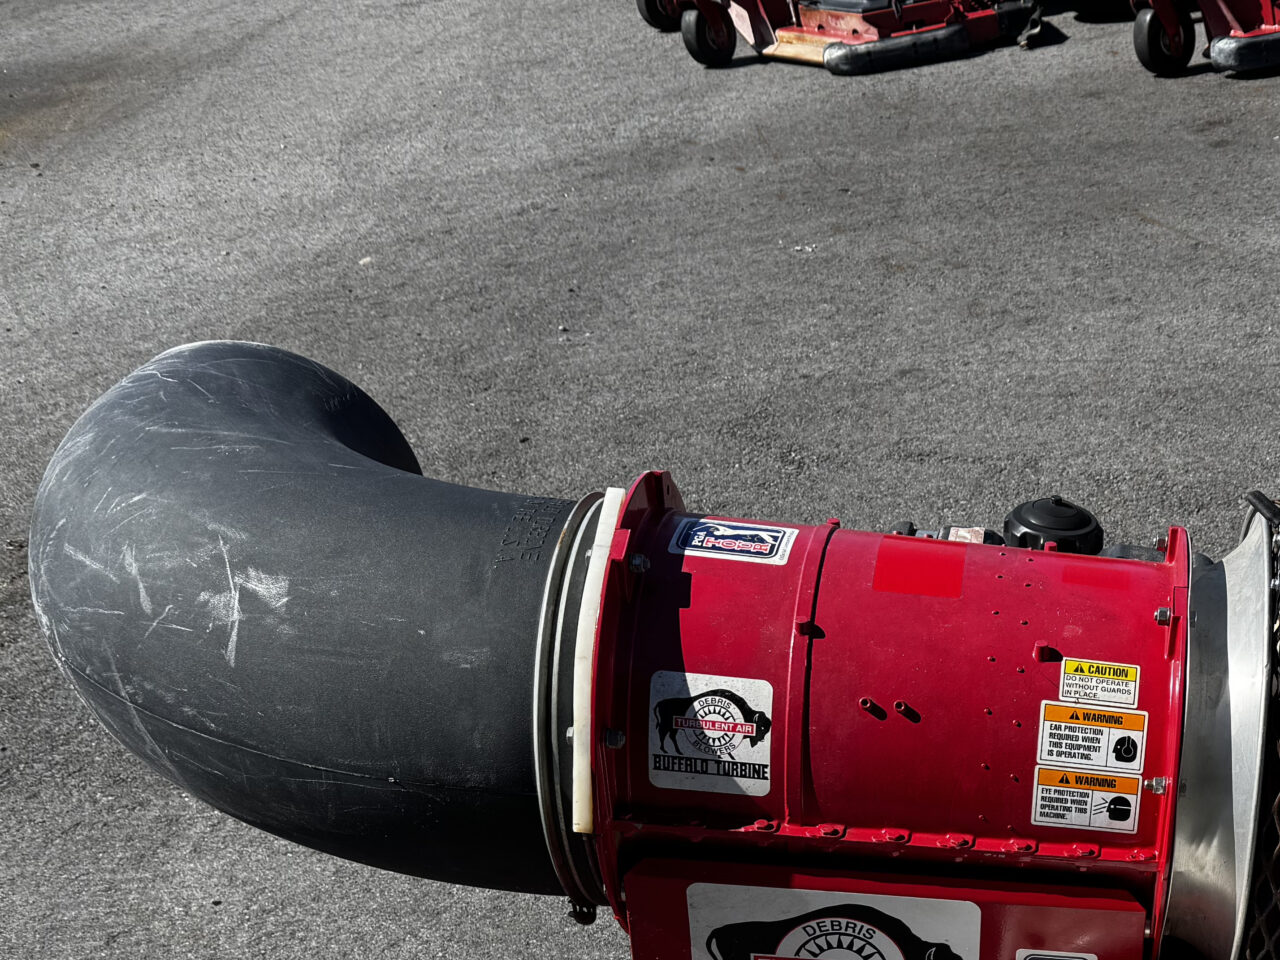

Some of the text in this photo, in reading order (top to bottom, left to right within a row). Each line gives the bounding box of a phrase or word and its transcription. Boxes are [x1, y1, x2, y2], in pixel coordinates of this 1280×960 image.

[691, 531, 707, 546] PGA
[703, 537, 771, 553] TOUR
[1088, 664, 1129, 678] CAUTION
[1065, 682, 1132, 696] WITHOUT GUARDS
[1095, 679, 1130, 688] OPERATE
[698, 697, 732, 710] DEBRIS
[676, 718, 752, 733] TURBULENT AIR
[1082, 711, 1124, 726] WARNING
[1049, 723, 1104, 736] EAR PROTECTION
[1049, 732, 1101, 744] REQUIRED WHEN
[694, 740, 736, 755] BLOWERS
[1049, 740, 1102, 753] THIS EQUIPMENT
[1055, 750, 1093, 761] OPERATING.
[652, 754, 769, 780] BUFFALO TURBINE
[1074, 775, 1117, 789] WARNING
[1041, 787, 1090, 799] EYE PROTECTION
[1041, 795, 1088, 806] REQUIRED WHEN
[1040, 804, 1088, 814] OPERATING THIS
[802, 919, 877, 940] DEBRIS
